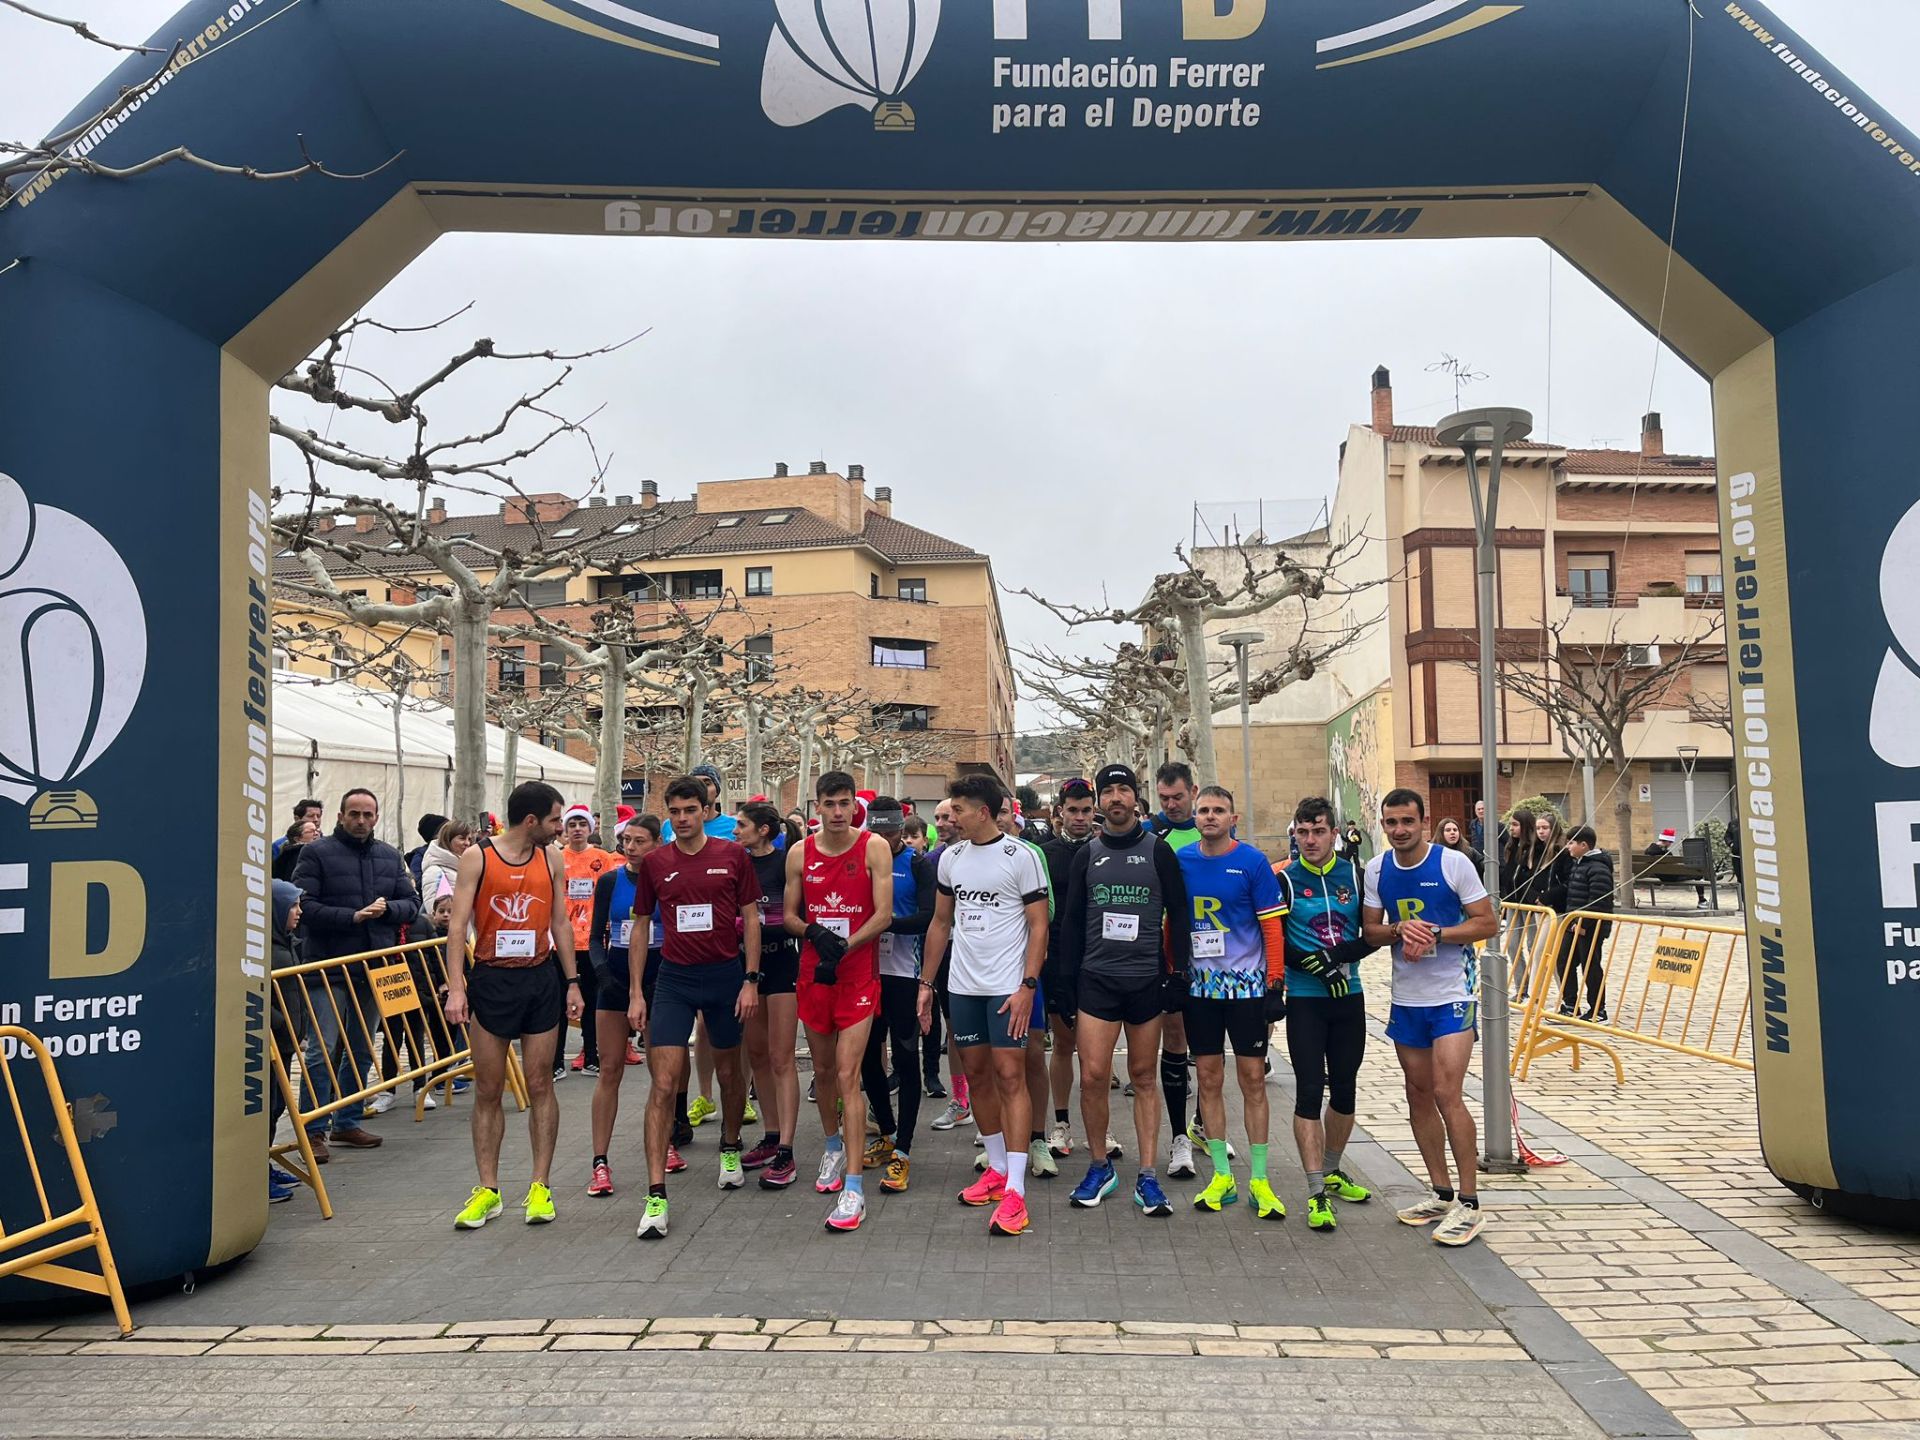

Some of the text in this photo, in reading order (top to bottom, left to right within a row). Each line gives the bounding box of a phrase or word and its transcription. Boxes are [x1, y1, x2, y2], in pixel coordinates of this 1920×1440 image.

[994, 56, 1265, 88] Fundación Ferrer
[992, 97, 1260, 133] para el Deporte
[604, 200, 1423, 239] www.fundacionferrer.org
[1729, 472, 1790, 1054] www.fundacionferrer.org
[241, 488, 269, 1116] www.fundacionferrer.org
[1111, 884, 1150, 896] muro
[1112, 895, 1149, 904] asensio
[808, 904, 827, 914] Caja
[839, 904, 863, 913] Soria
[1194, 922, 1211, 930] CLUB
[35, 994, 142, 1023] Ferrer
